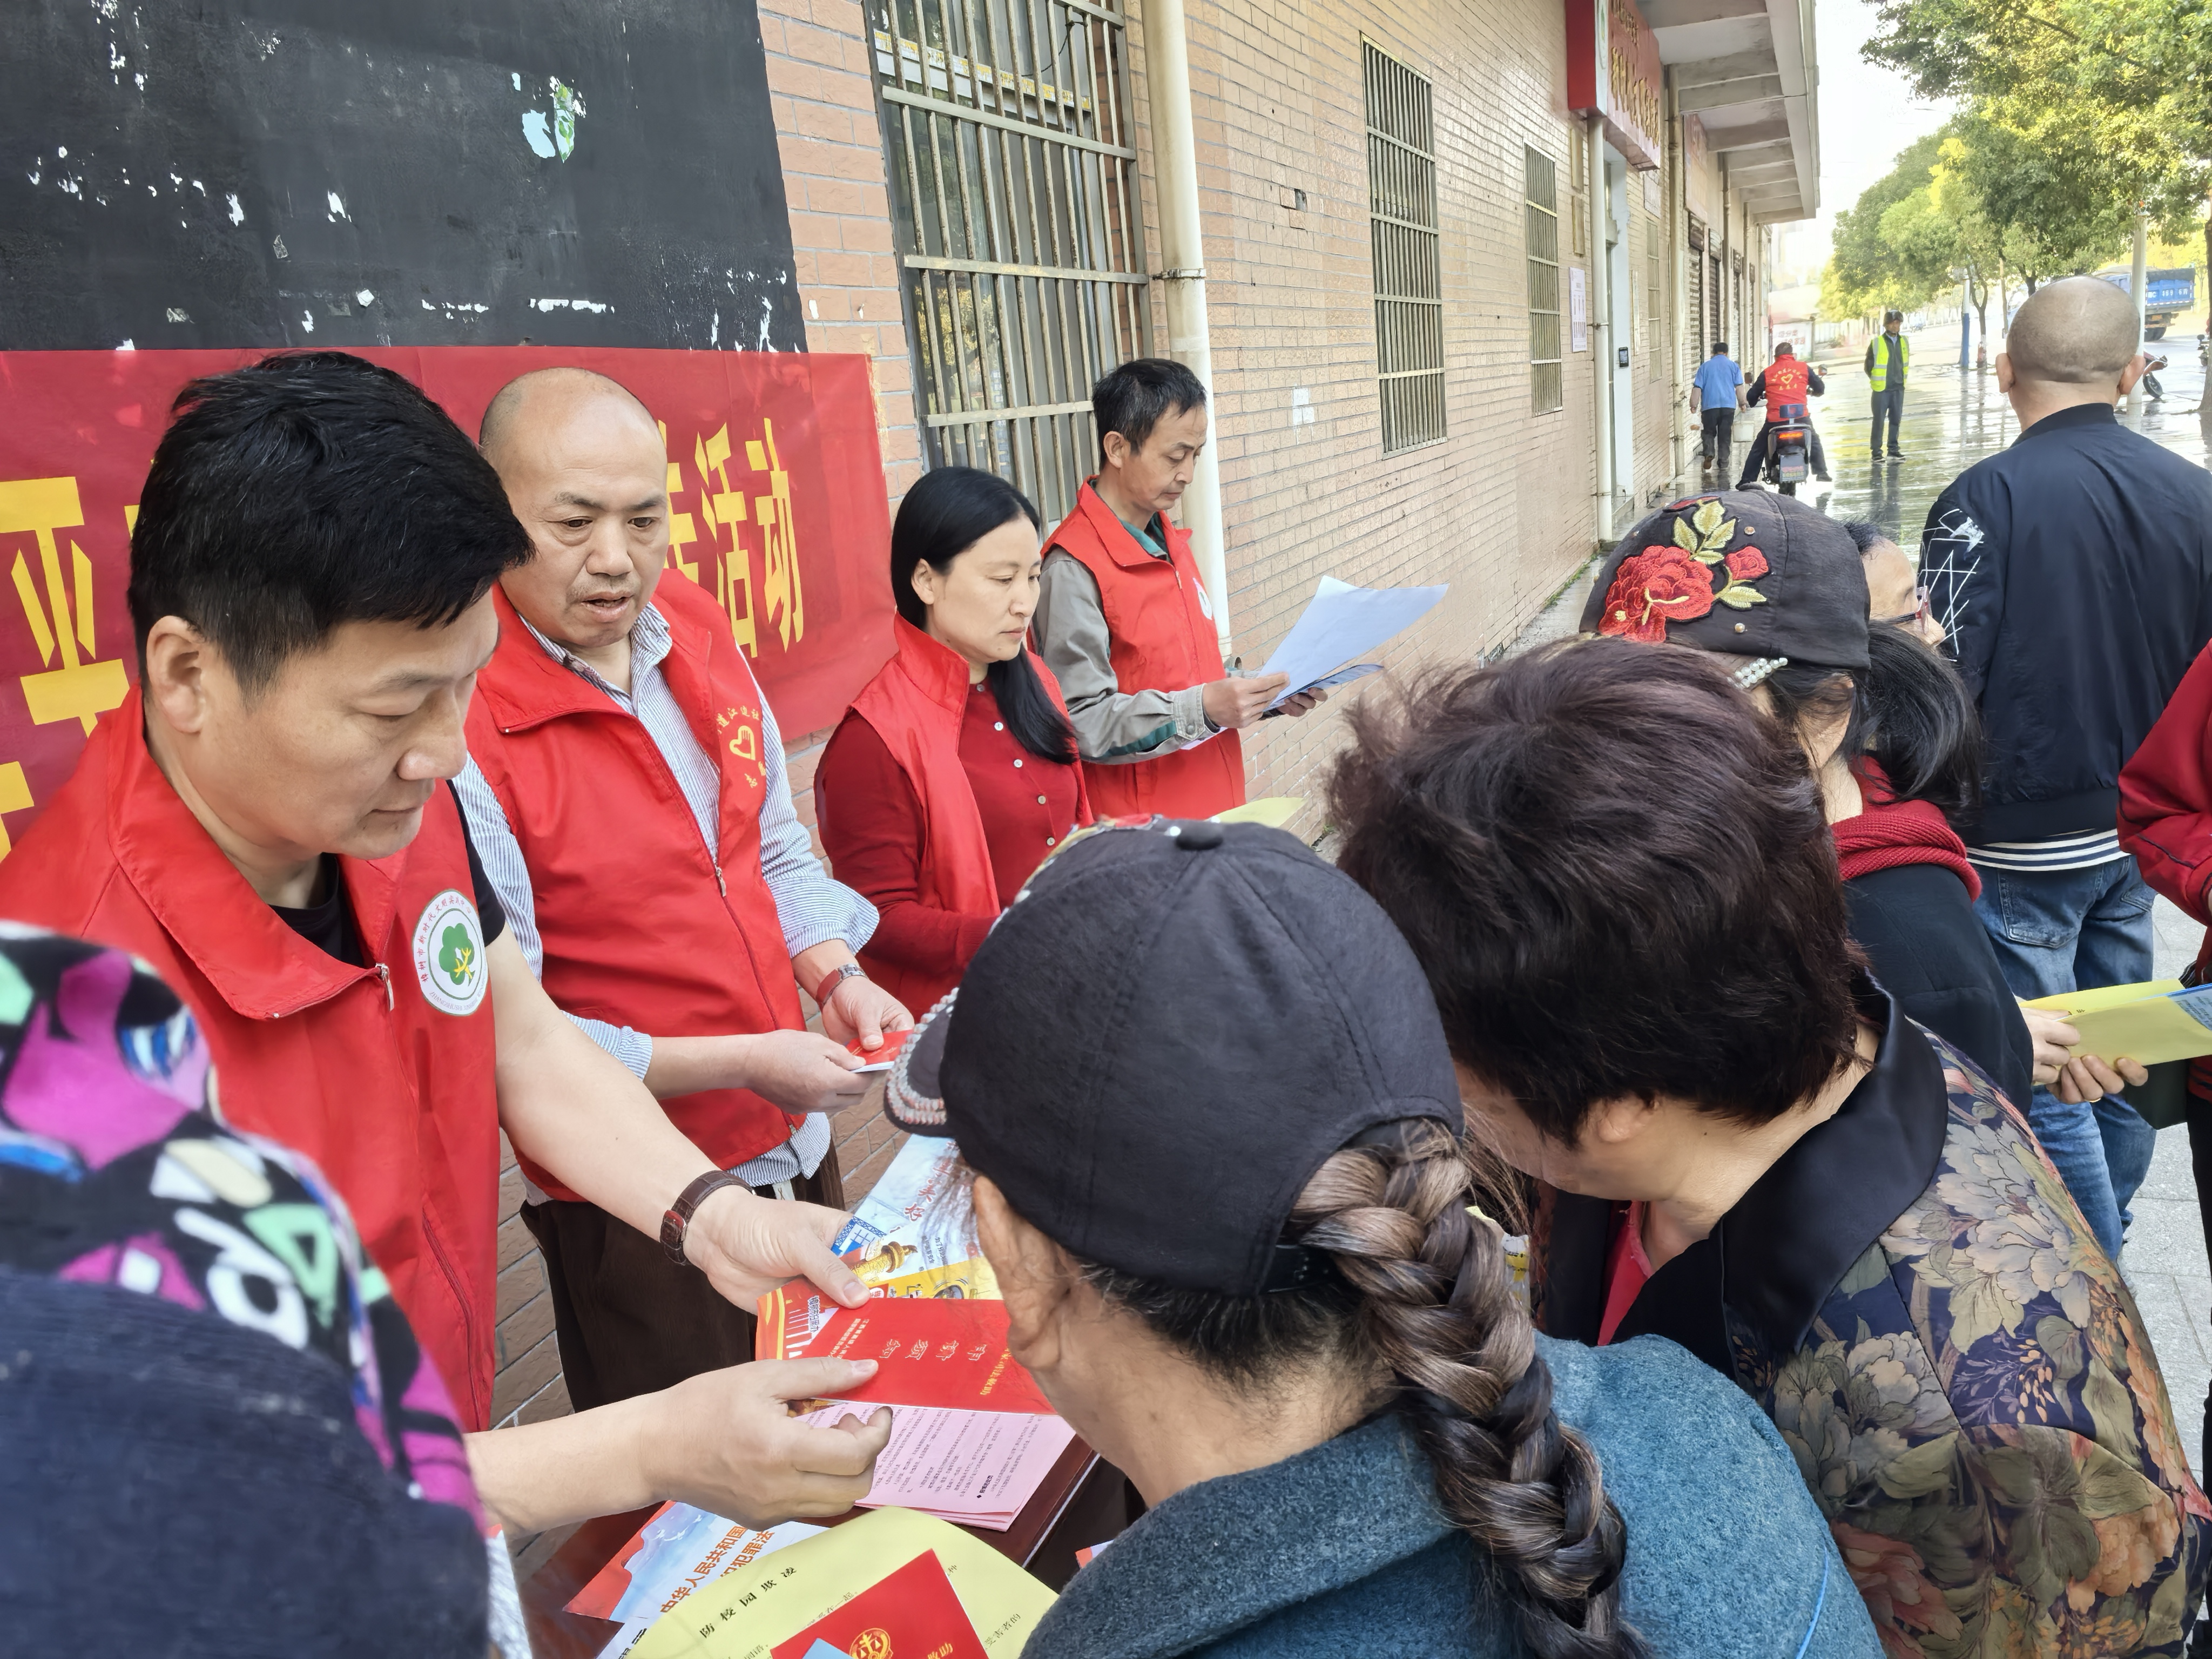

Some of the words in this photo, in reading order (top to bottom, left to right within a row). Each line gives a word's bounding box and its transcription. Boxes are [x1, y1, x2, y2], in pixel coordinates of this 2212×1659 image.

[980, 1348, 1011, 1395] 家司法救助
[660, 1526, 749, 1613] 中华人民共和国
